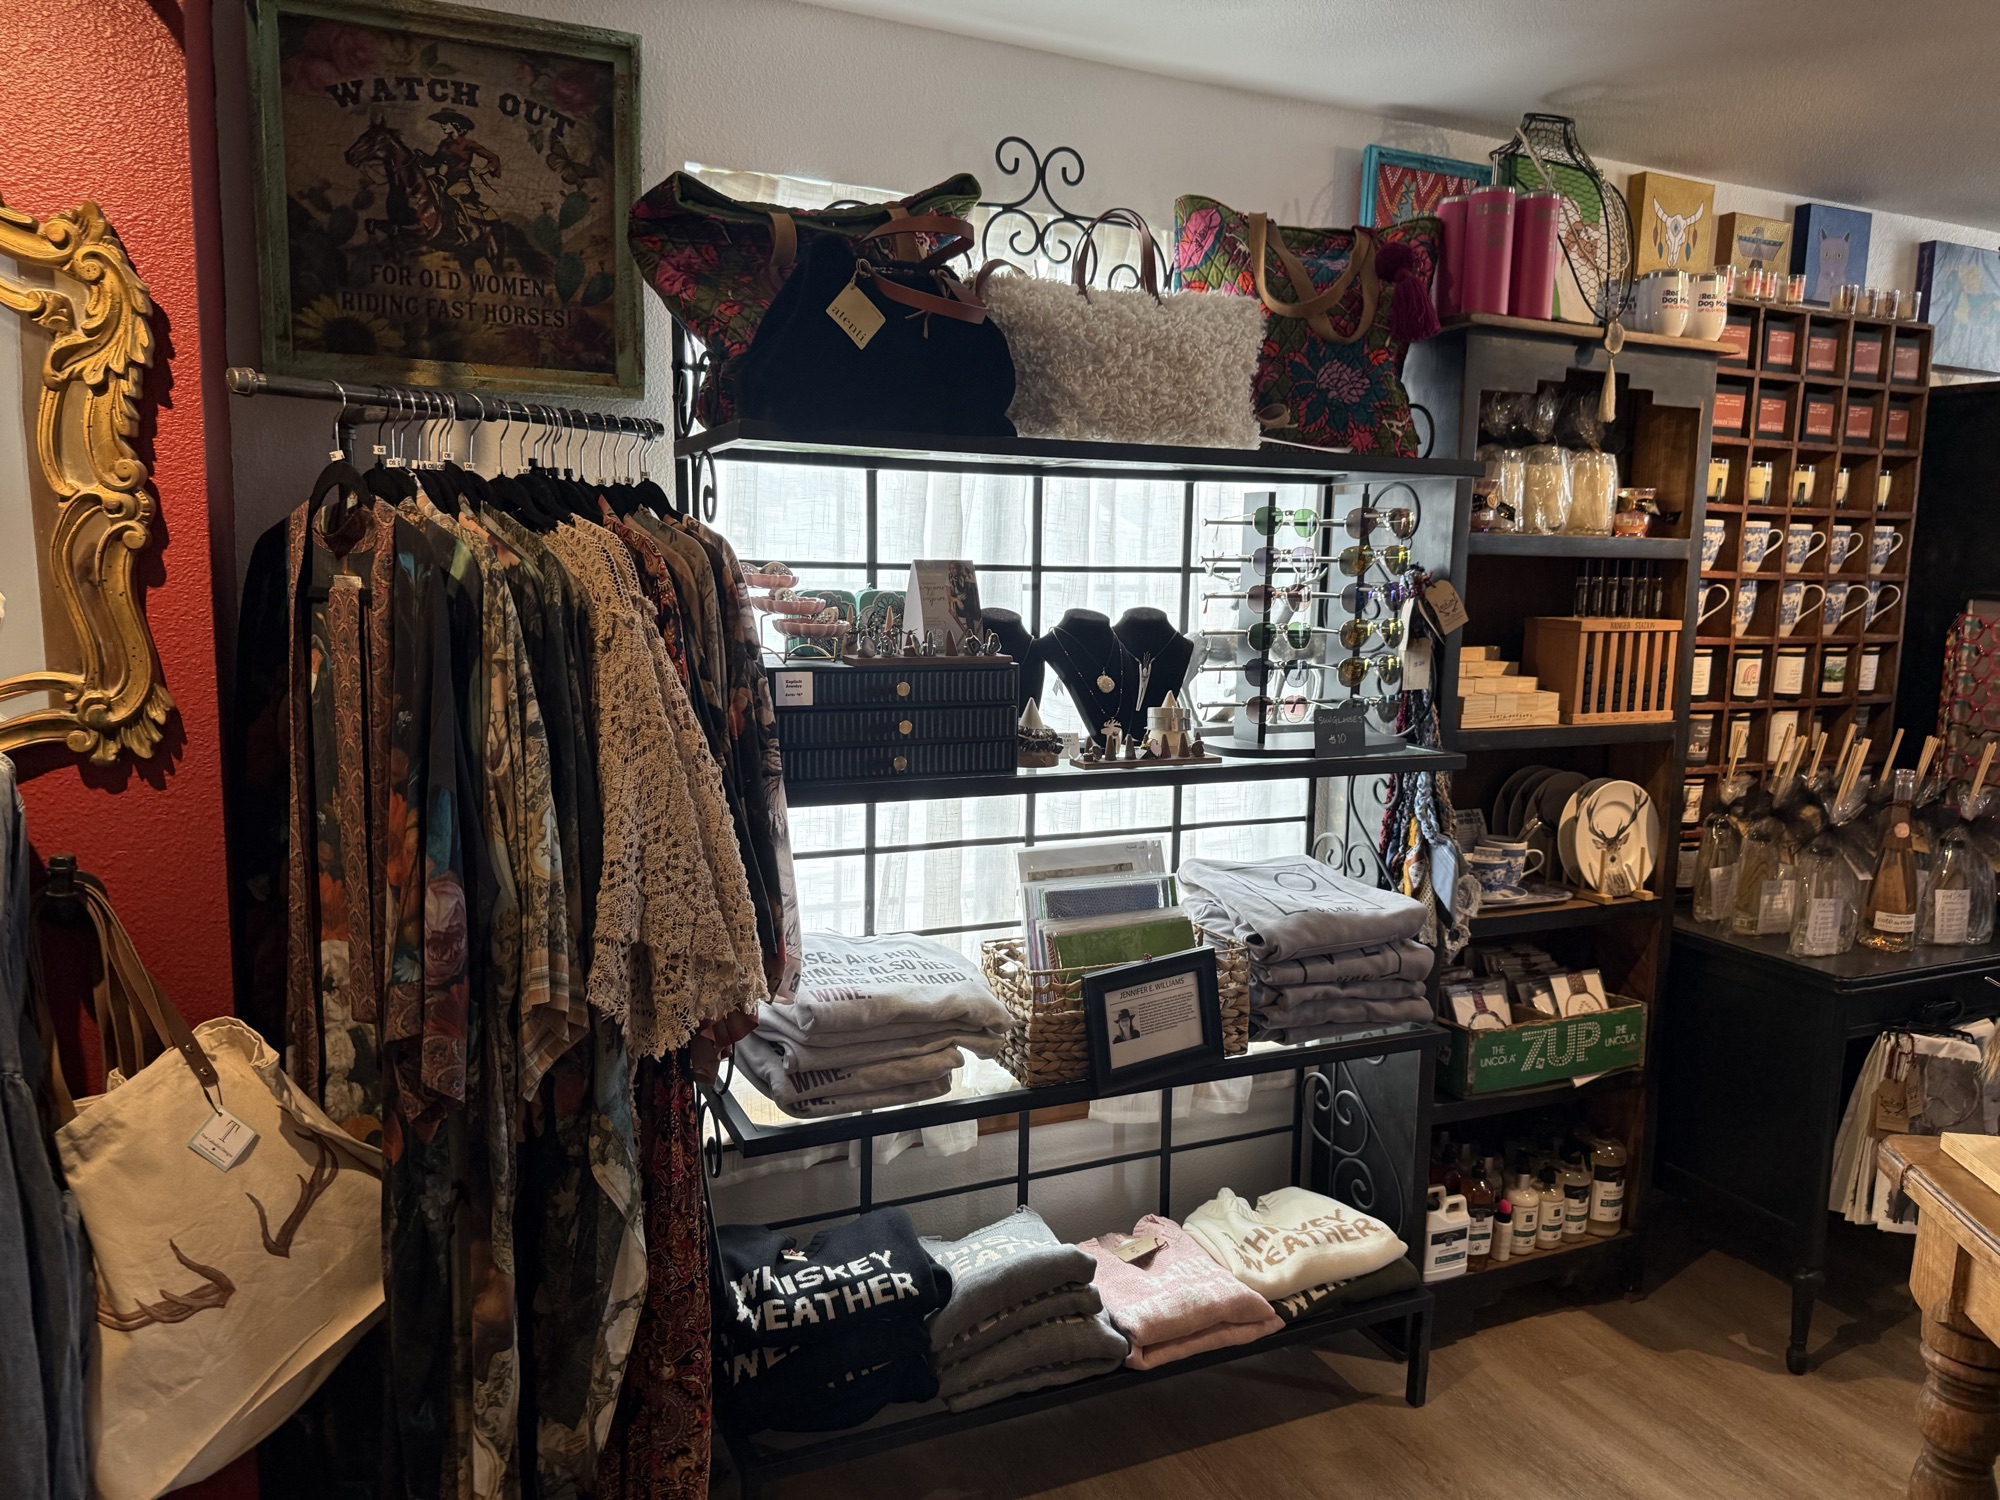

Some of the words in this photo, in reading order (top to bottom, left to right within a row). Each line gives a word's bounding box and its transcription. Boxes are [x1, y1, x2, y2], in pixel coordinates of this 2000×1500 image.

[327, 77, 480, 107] WATCH
[498, 93, 576, 138] OUT
[370, 264, 412, 287] FOR
[419, 272, 461, 291] OLD
[469, 275, 546, 298] WOMEN
[1666, 289, 1681, 297] Rea
[1662, 297, 1678, 305] Dog
[341, 291, 419, 315] RIDING
[426, 301, 477, 322] FAST
[483, 303, 573, 329] HORSES!
[1318, 715, 1363, 725] SUNGLASSES
[1328, 732, 1347, 744] $10
[846, 953, 881, 965] ARE
[868, 960, 917, 976] ALSO
[874, 974, 910, 985] ARE
[913, 971, 974, 986] HARD,
[809, 986, 872, 1003] WINE.
[1120, 986, 1148, 999] JENNIFER
[1155, 977, 1185, 990] WILLIAMS
[1615, 1025, 1628, 1035] THE
[1605, 1034, 1636, 1047] UNCOLA
[1492, 1045, 1505, 1055] THE
[1480, 1053, 1517, 1068] UNCOLA
[1233, 1217, 1380, 1273] WEATHER
[730, 1250, 892, 1299] WHISKEY
[735, 1272, 919, 1332] WEATHER
